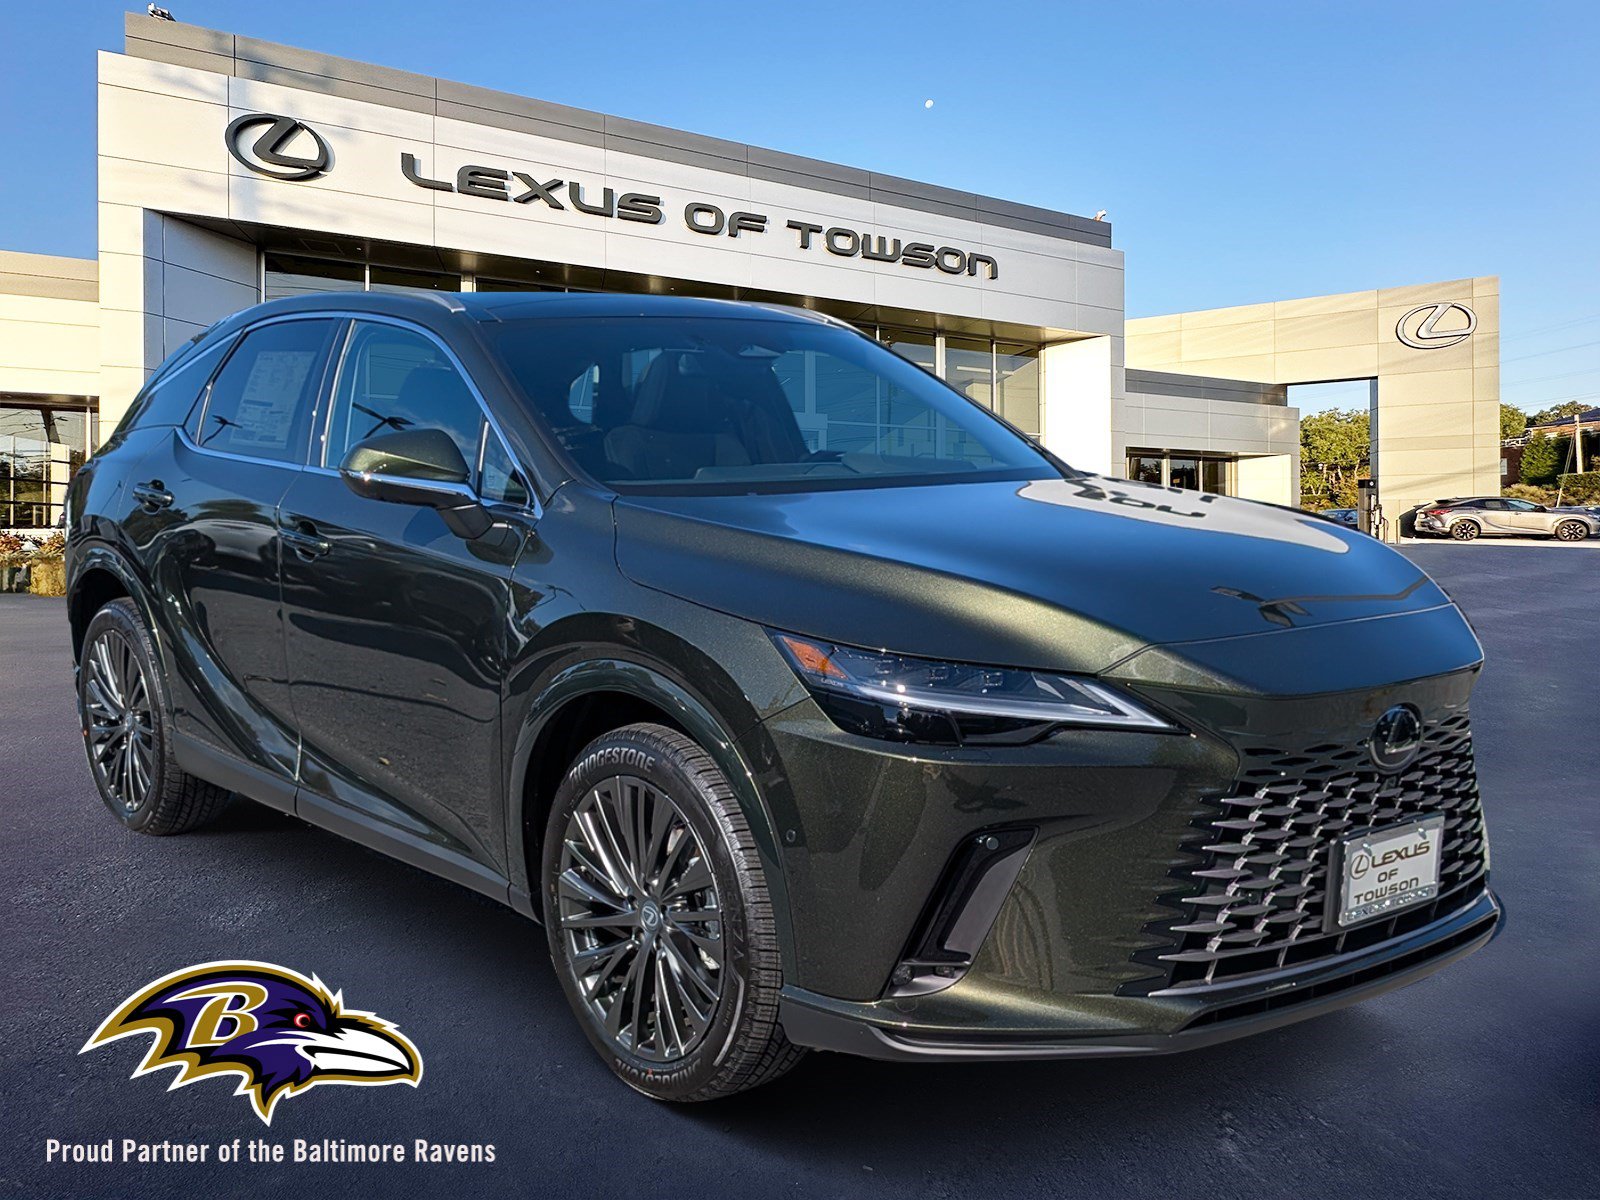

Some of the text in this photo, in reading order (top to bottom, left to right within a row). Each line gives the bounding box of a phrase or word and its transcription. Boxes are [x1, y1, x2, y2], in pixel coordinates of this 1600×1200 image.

[401, 152, 999, 280] LEXUS OF TOWSON
[1371, 841, 1430, 868] LEXUS
[1377, 867, 1399, 884] OF
[1354, 877, 1419, 904] TOWSON
